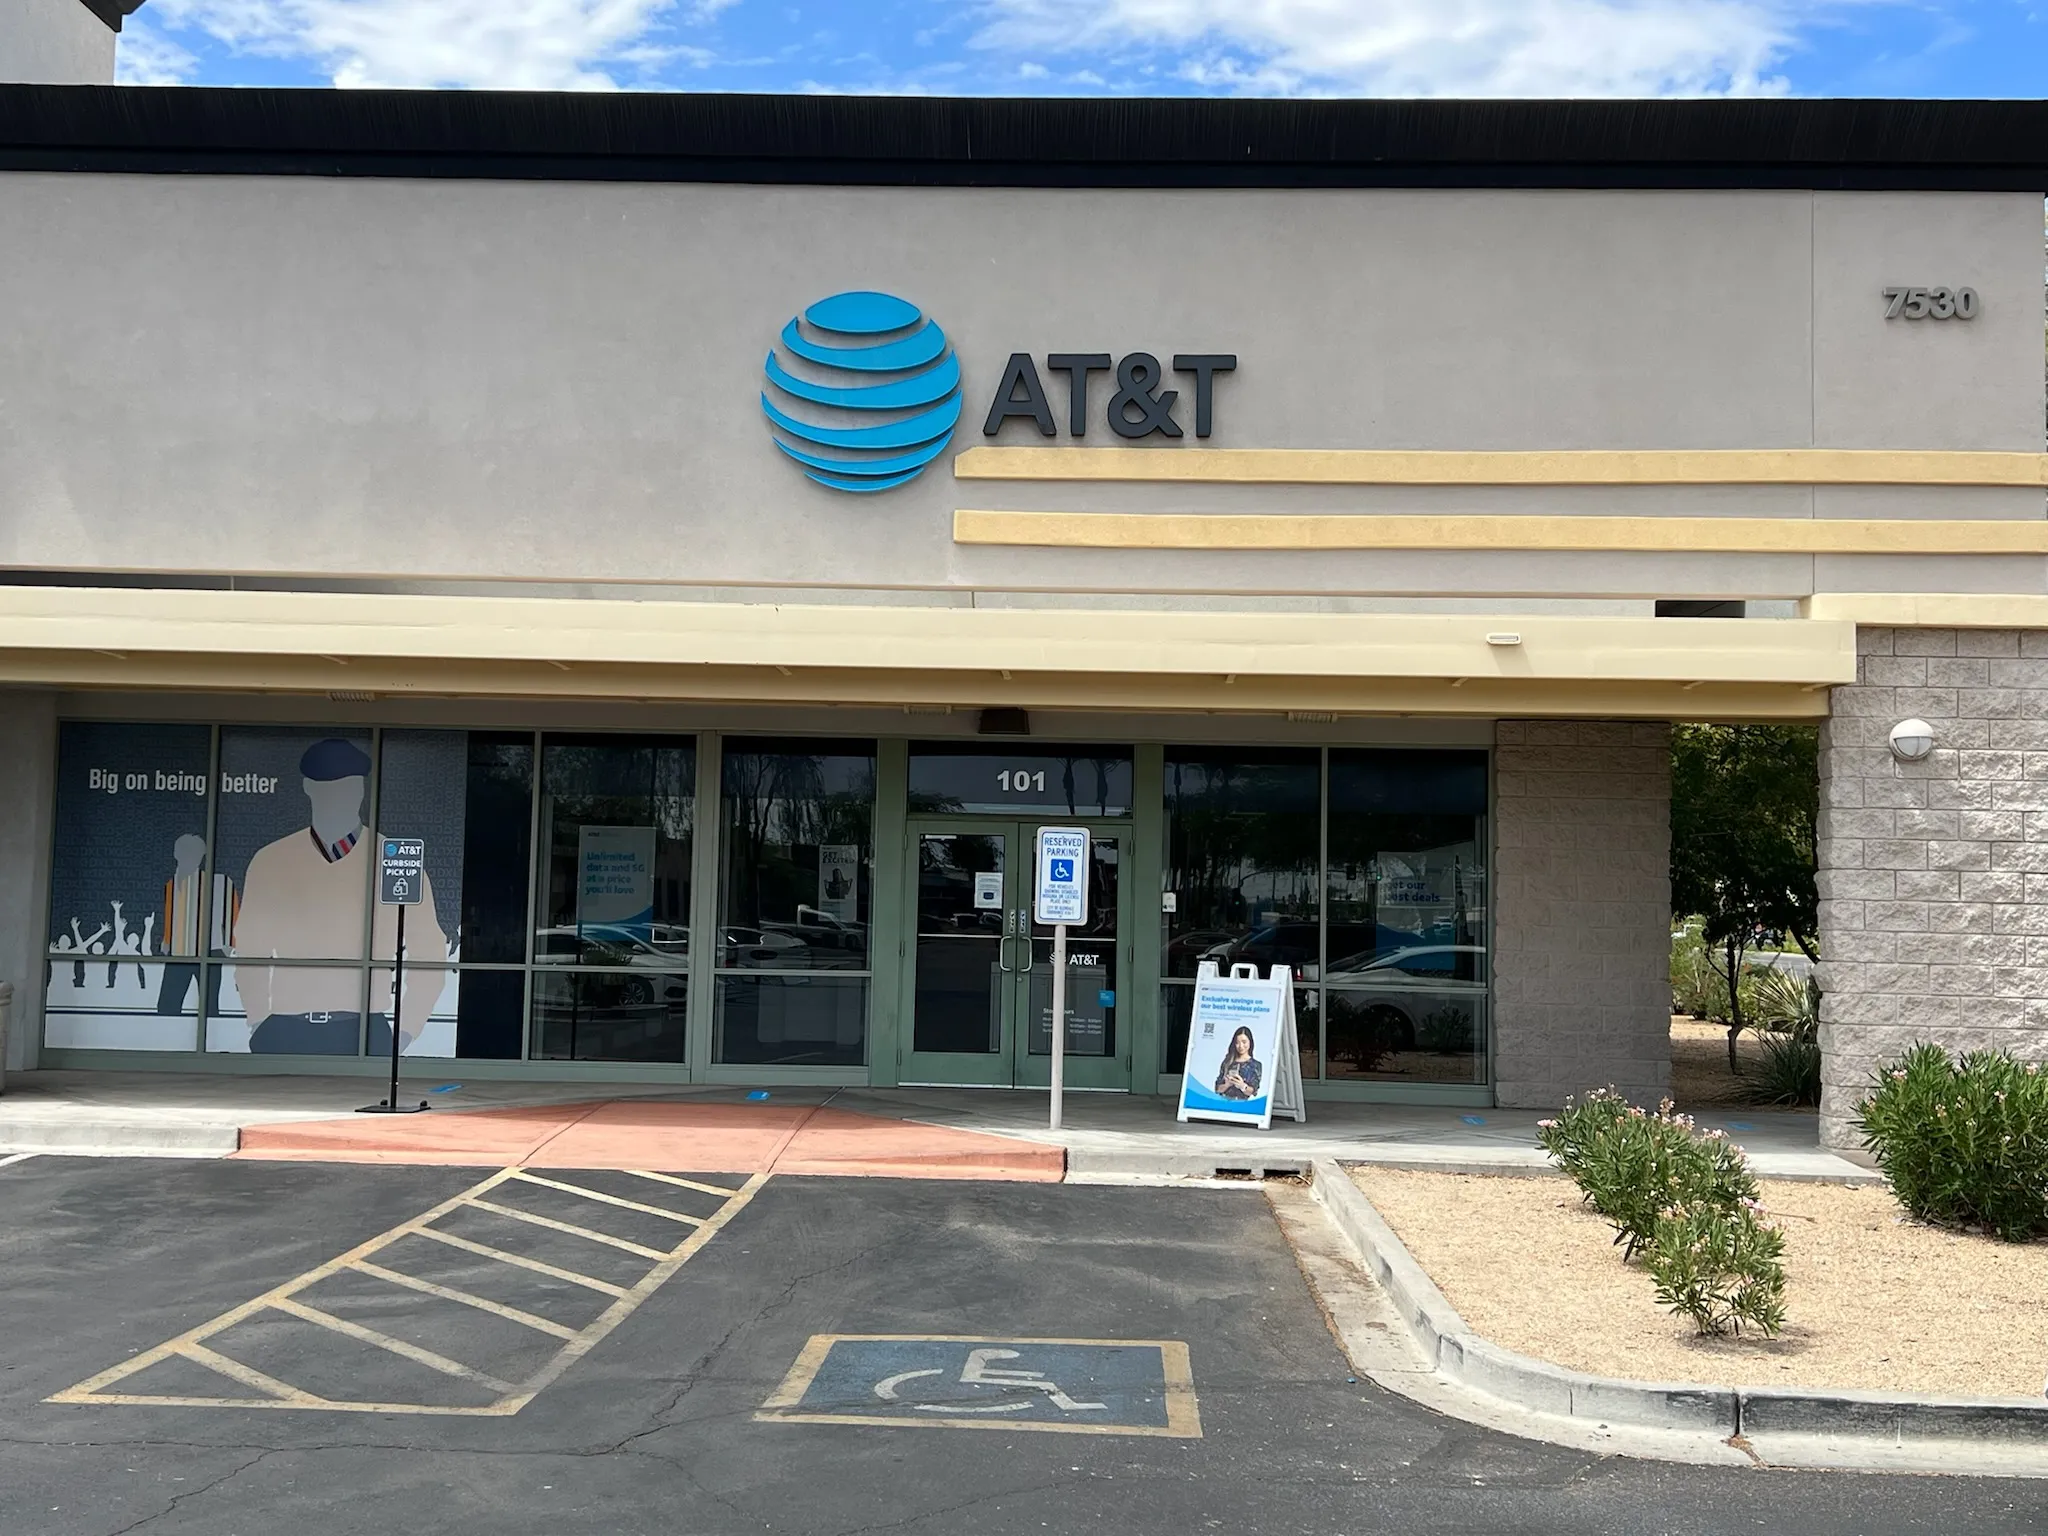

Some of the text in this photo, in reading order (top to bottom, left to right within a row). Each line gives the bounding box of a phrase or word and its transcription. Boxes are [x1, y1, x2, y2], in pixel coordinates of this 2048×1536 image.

[1883, 287, 1980, 320] 7530
[983, 352, 1237, 438] AT&T
[89, 769, 278, 796] Big on being better
[997, 770, 1045, 791] 101
[1045, 837, 1081, 847] RESERVED
[398, 846, 421, 855] AT&T
[1047, 848, 1079, 857] PARKING
[587, 852, 636, 861] Unlimited
[386, 868, 404, 876] PICK
[586, 863, 645, 872] data and 5G
[607, 875, 631, 885] price
[614, 886, 635, 894] love
[1412, 892, 1440, 902] deals
[1069, 954, 1099, 965] AT&T
